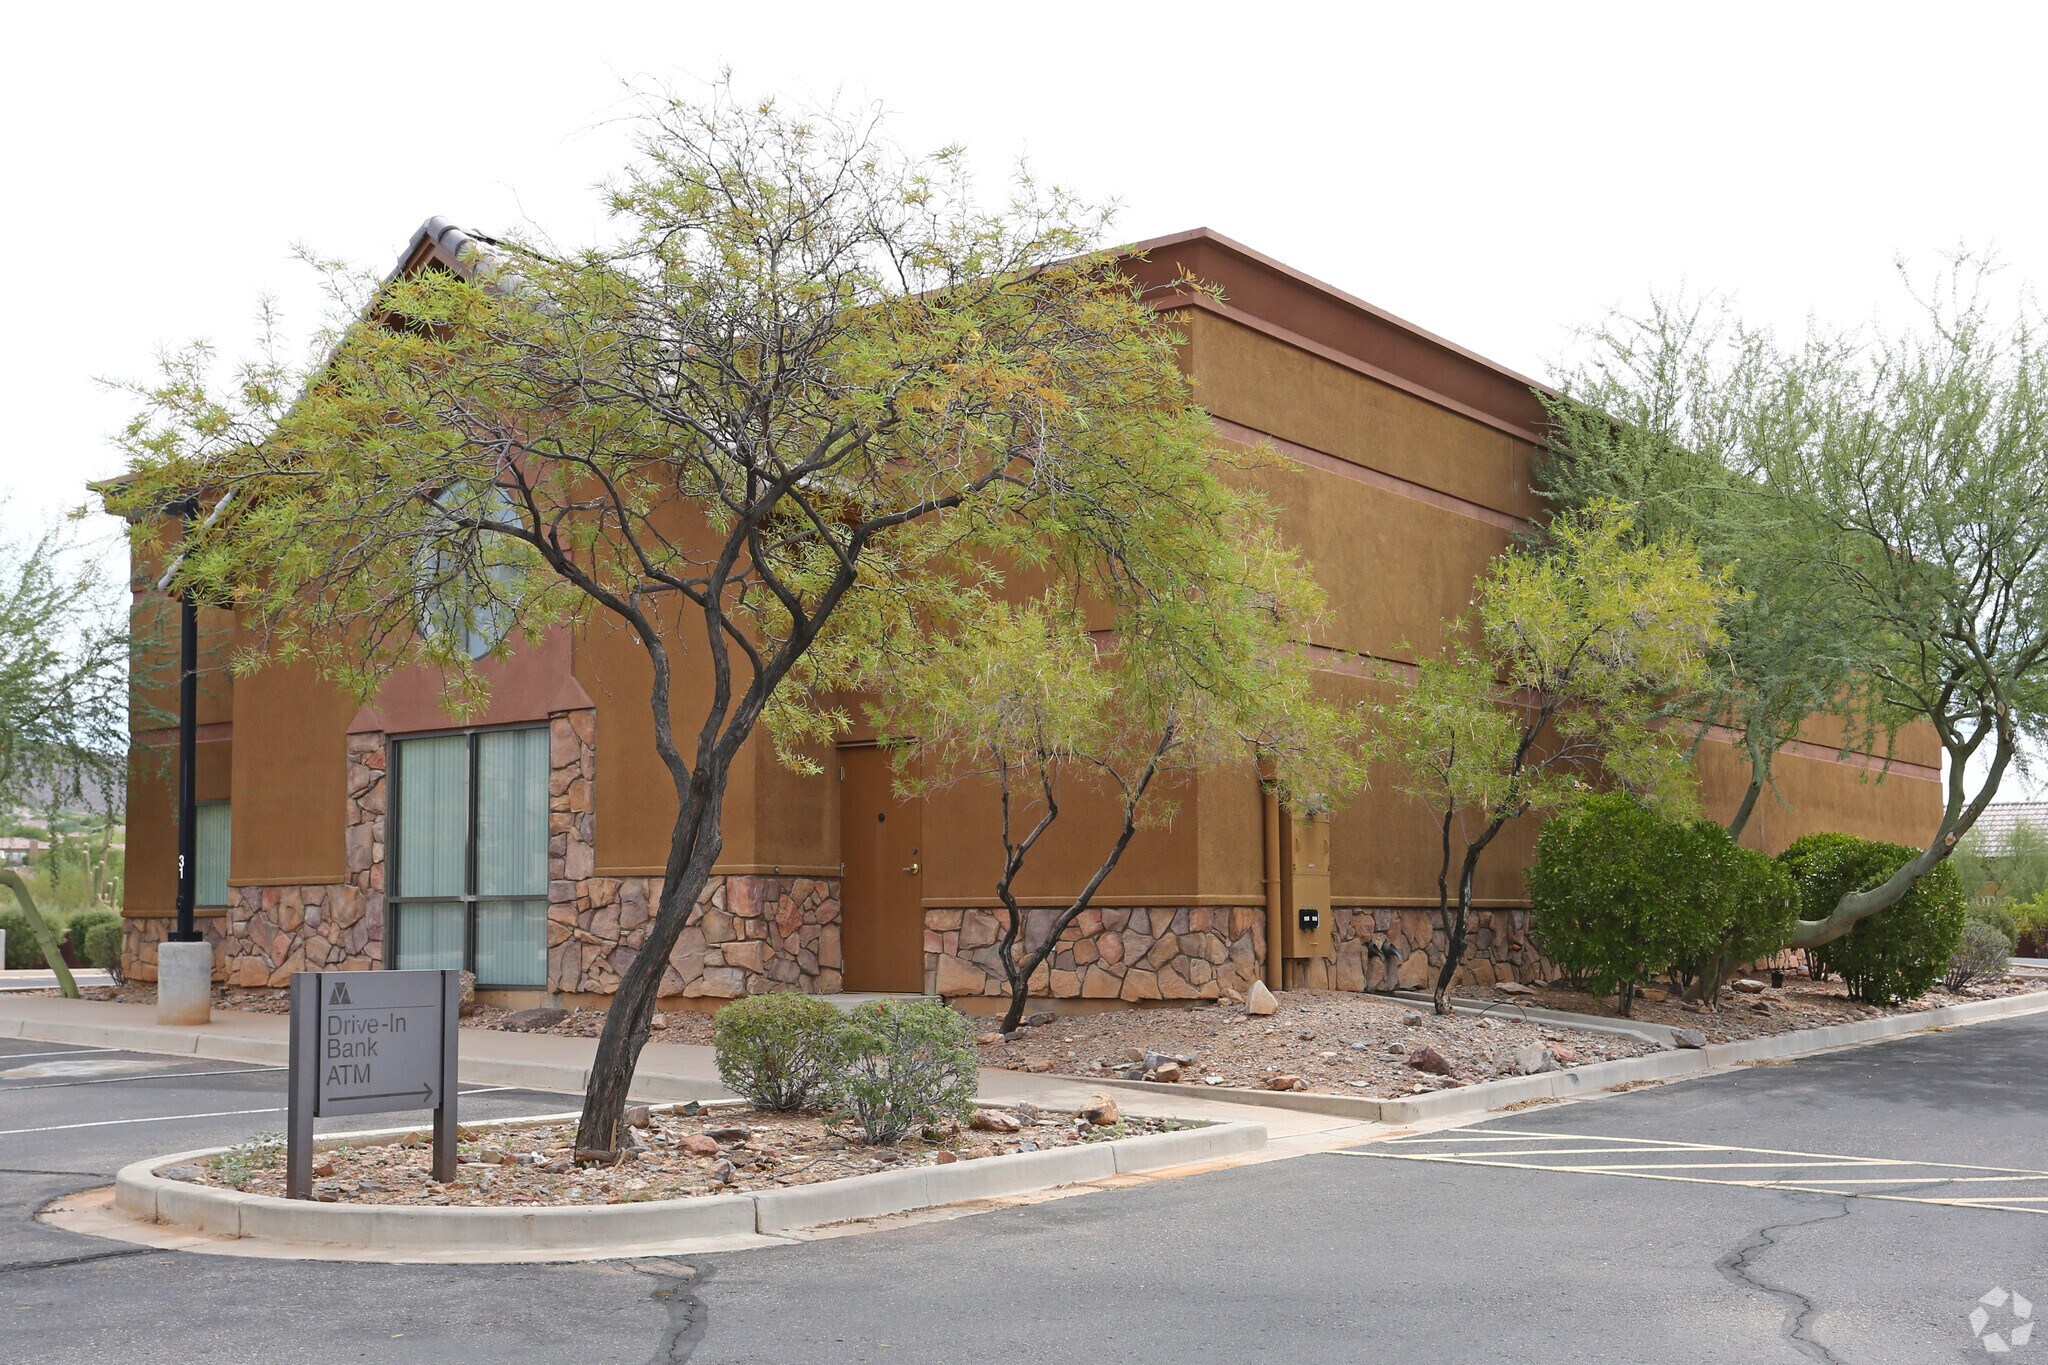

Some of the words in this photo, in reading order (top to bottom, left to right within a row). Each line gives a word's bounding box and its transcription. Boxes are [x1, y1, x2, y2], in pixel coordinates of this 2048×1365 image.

[327, 1012, 407, 1036] Drive-In
[327, 1036, 379, 1059] Bank
[326, 1063, 371, 1086] ATM
